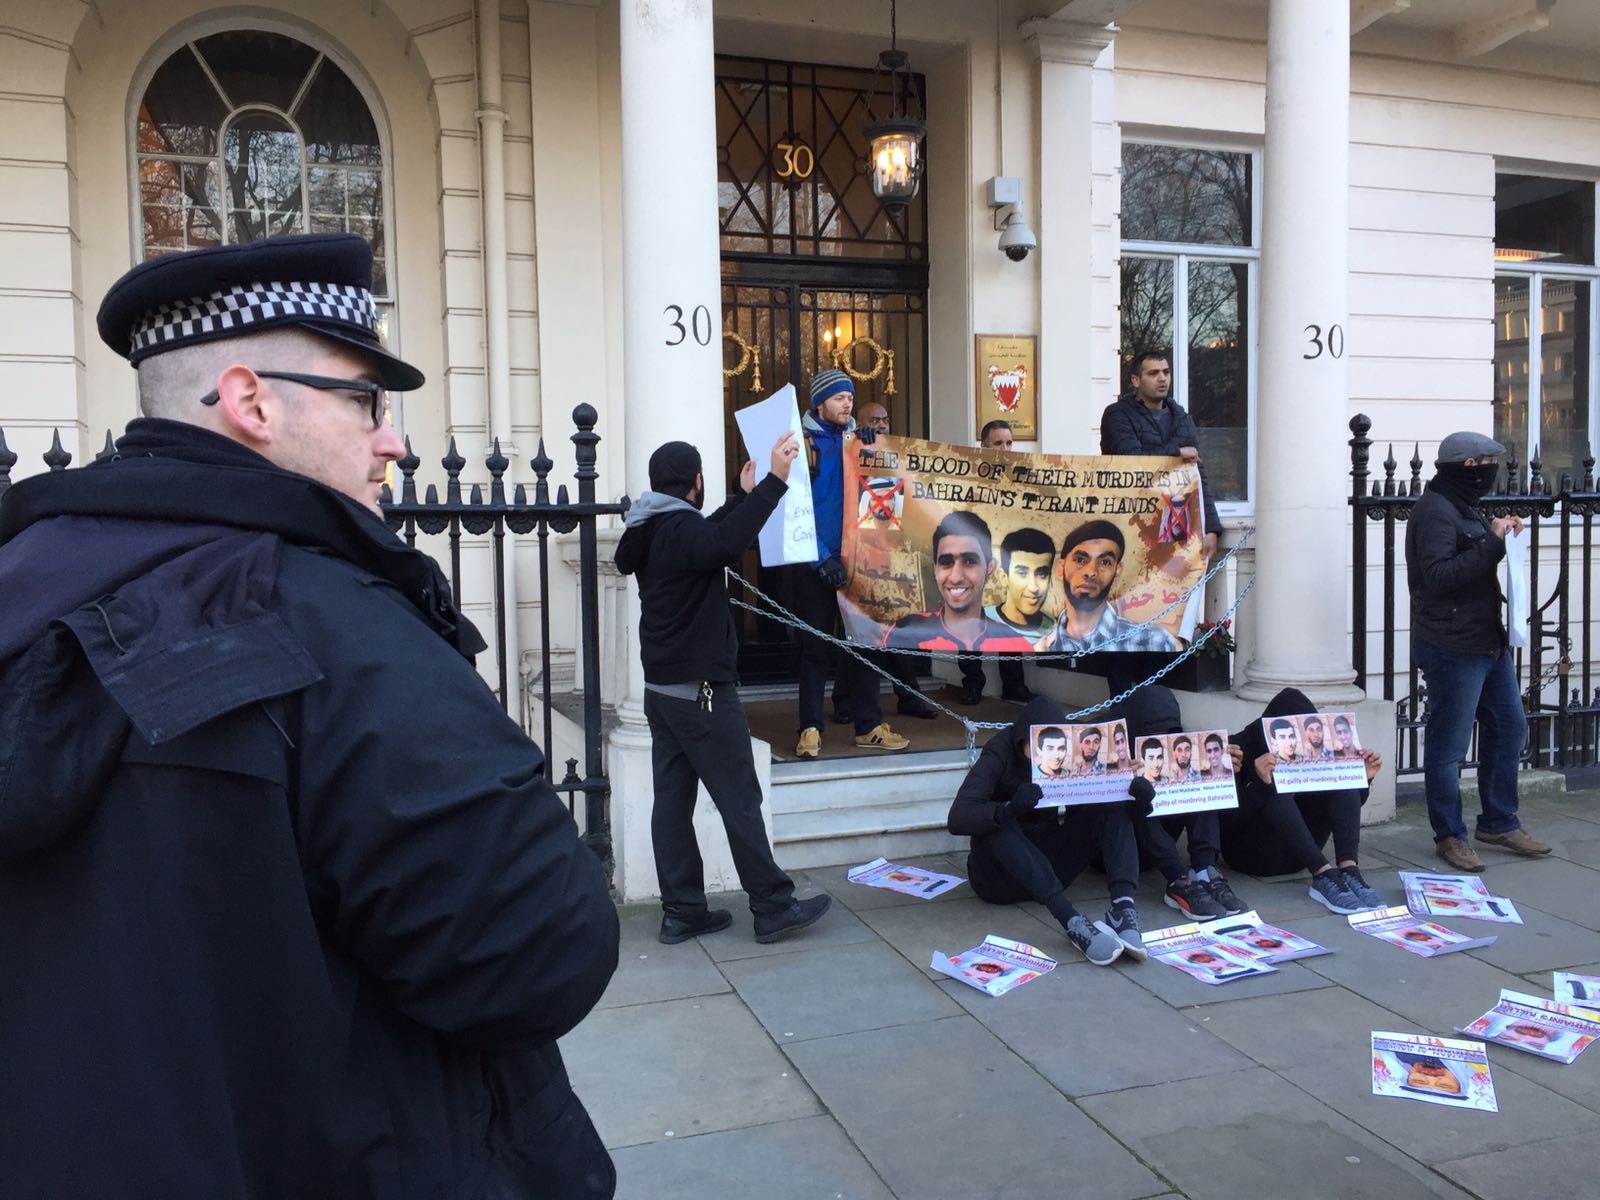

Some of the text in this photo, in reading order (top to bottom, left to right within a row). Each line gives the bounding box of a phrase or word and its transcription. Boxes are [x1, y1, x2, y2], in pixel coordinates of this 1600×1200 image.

[776, 143, 814, 178] 30
[663, 304, 712, 347] 30
[1302, 323, 1345, 360] 30
[859, 448, 1192, 489] THE BLOOD OF THEIR MURDER IS IN
[912, 481, 1159, 514] BAHRAIN'S TYRANT HANDS
[1046, 792, 1064, 800] guilty
[1066, 790, 1073, 798] of
[1074, 788, 1106, 797] murdering
[1287, 777, 1302, 785] guilty
[1309, 775, 1338, 783] murdering
[1155, 799, 1170, 808] guilty
[1178, 796, 1207, 805] murdering
[1207, 793, 1234, 802] Bahrainis
